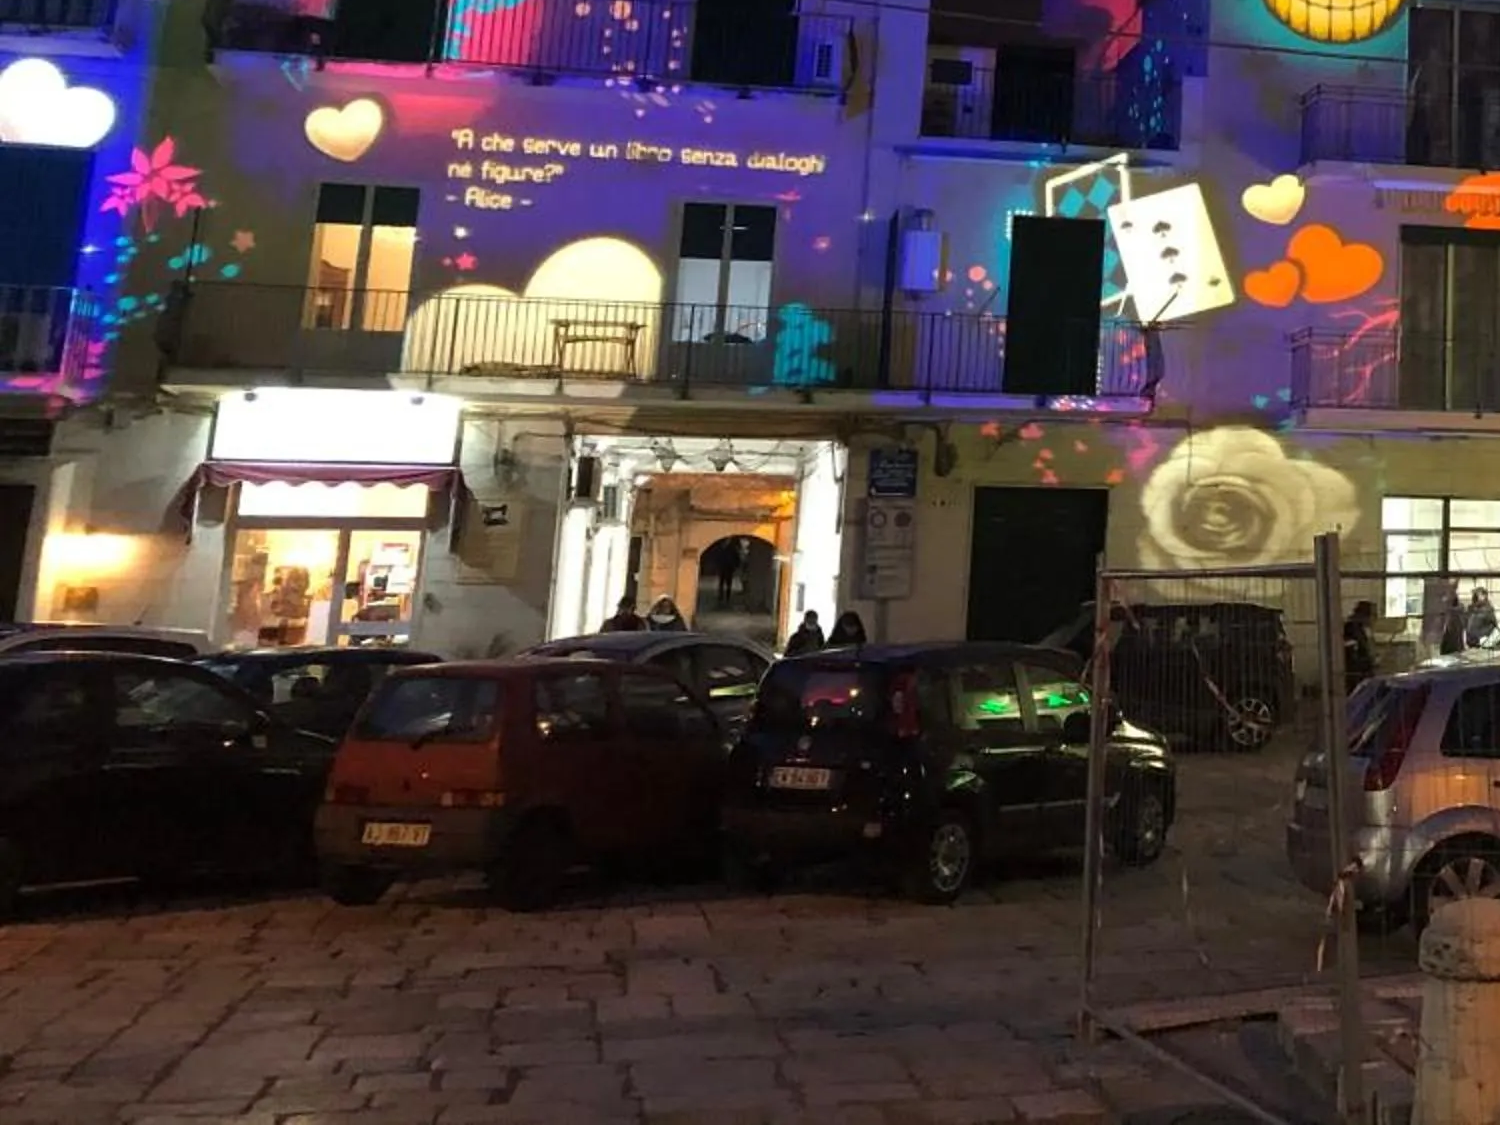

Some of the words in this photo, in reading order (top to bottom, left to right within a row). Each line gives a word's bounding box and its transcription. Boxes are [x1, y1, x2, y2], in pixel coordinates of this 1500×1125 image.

[481, 132, 515, 152] che
[523, 137, 580, 156] serve
[589, 143, 617, 159] un
[625, 140, 673, 162] libro
[681, 148, 738, 167] senza
[747, 151, 826, 175] dialoghi
[464, 186, 513, 209] Alice
